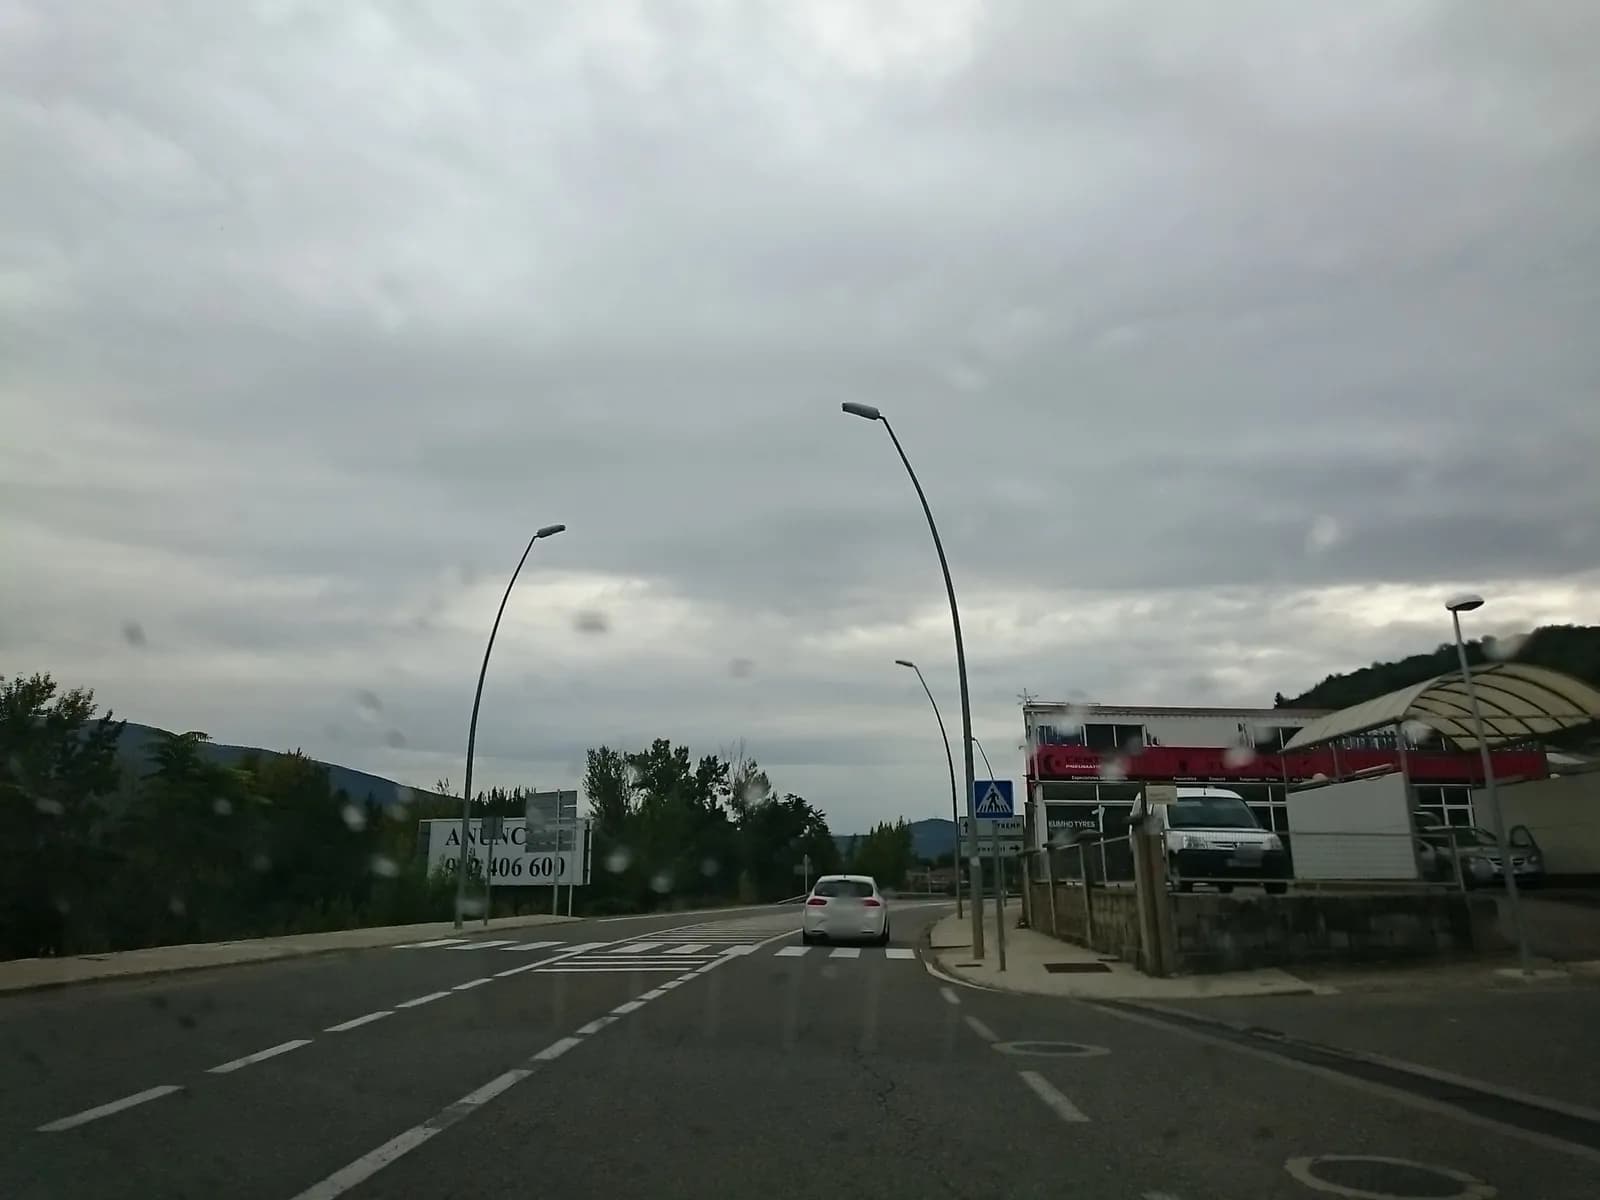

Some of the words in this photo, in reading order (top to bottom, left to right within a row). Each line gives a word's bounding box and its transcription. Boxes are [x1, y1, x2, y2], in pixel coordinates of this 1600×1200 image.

[1048, 819, 1074, 828] KUMHO
[1075, 819, 1096, 828] TYRES
[487, 857, 523, 877] 406
[529, 857, 565, 877] 600
